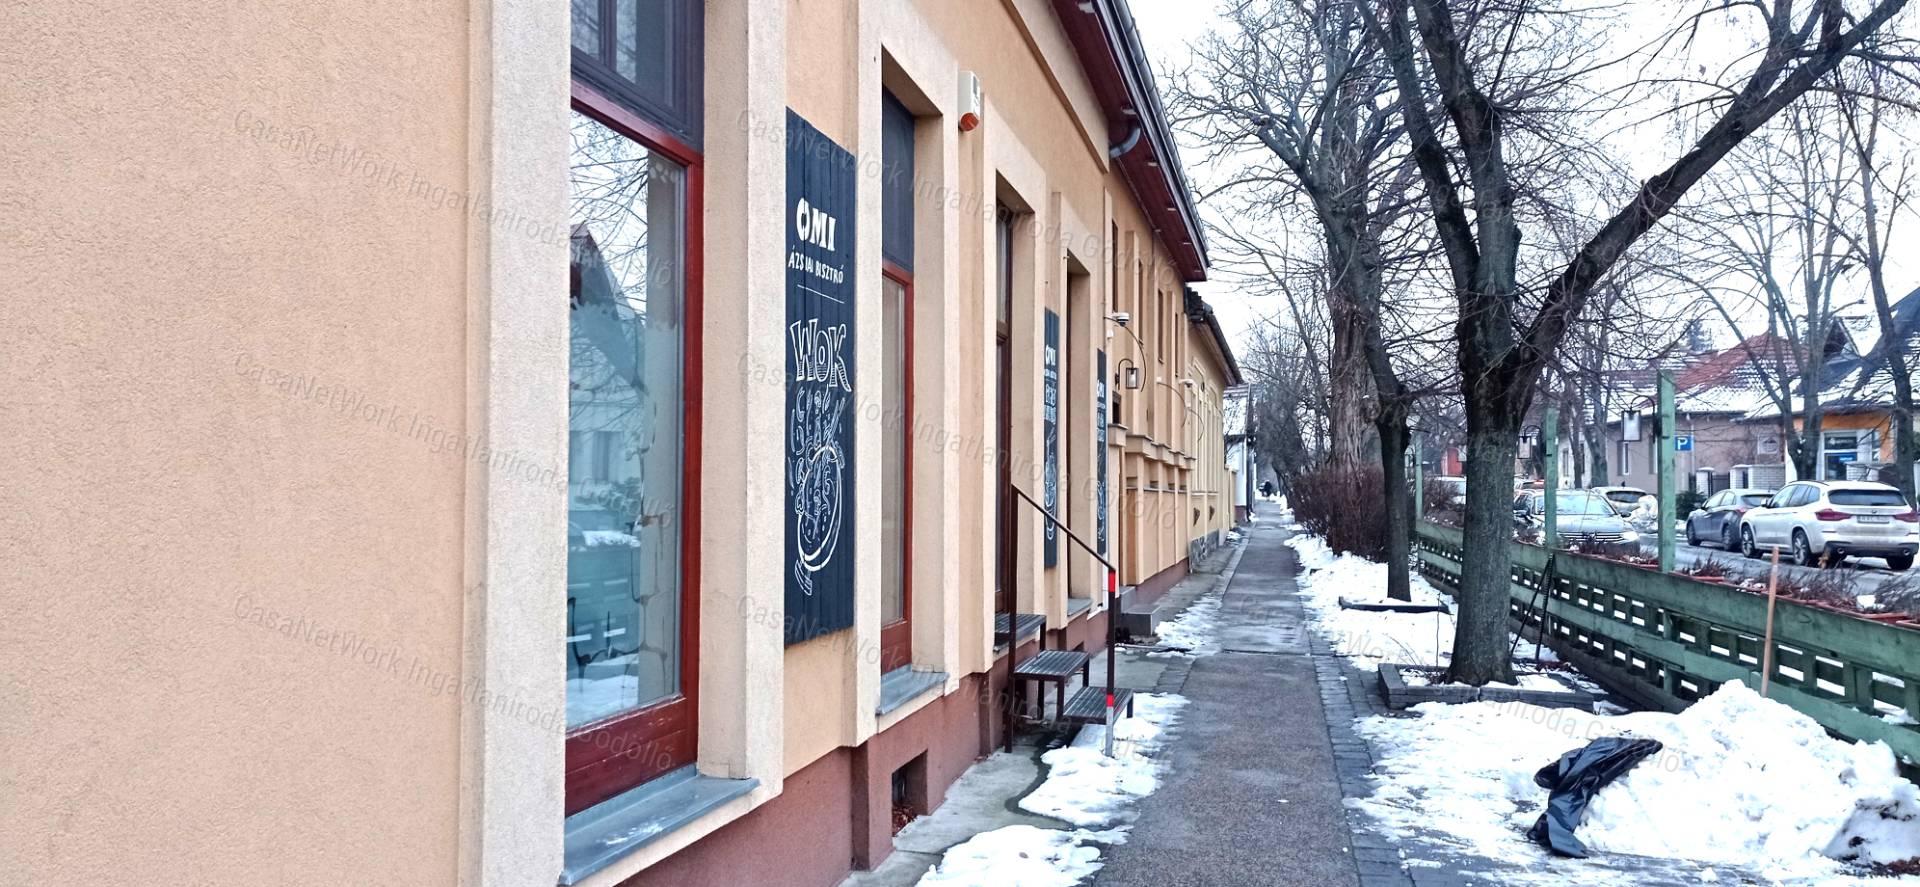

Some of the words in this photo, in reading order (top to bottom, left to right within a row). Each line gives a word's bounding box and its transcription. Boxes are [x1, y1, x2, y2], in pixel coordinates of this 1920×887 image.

[796, 197, 836, 251] OMI
[815, 264, 844, 285] BISZTRÓ
[1676, 437, 1687, 450] P
